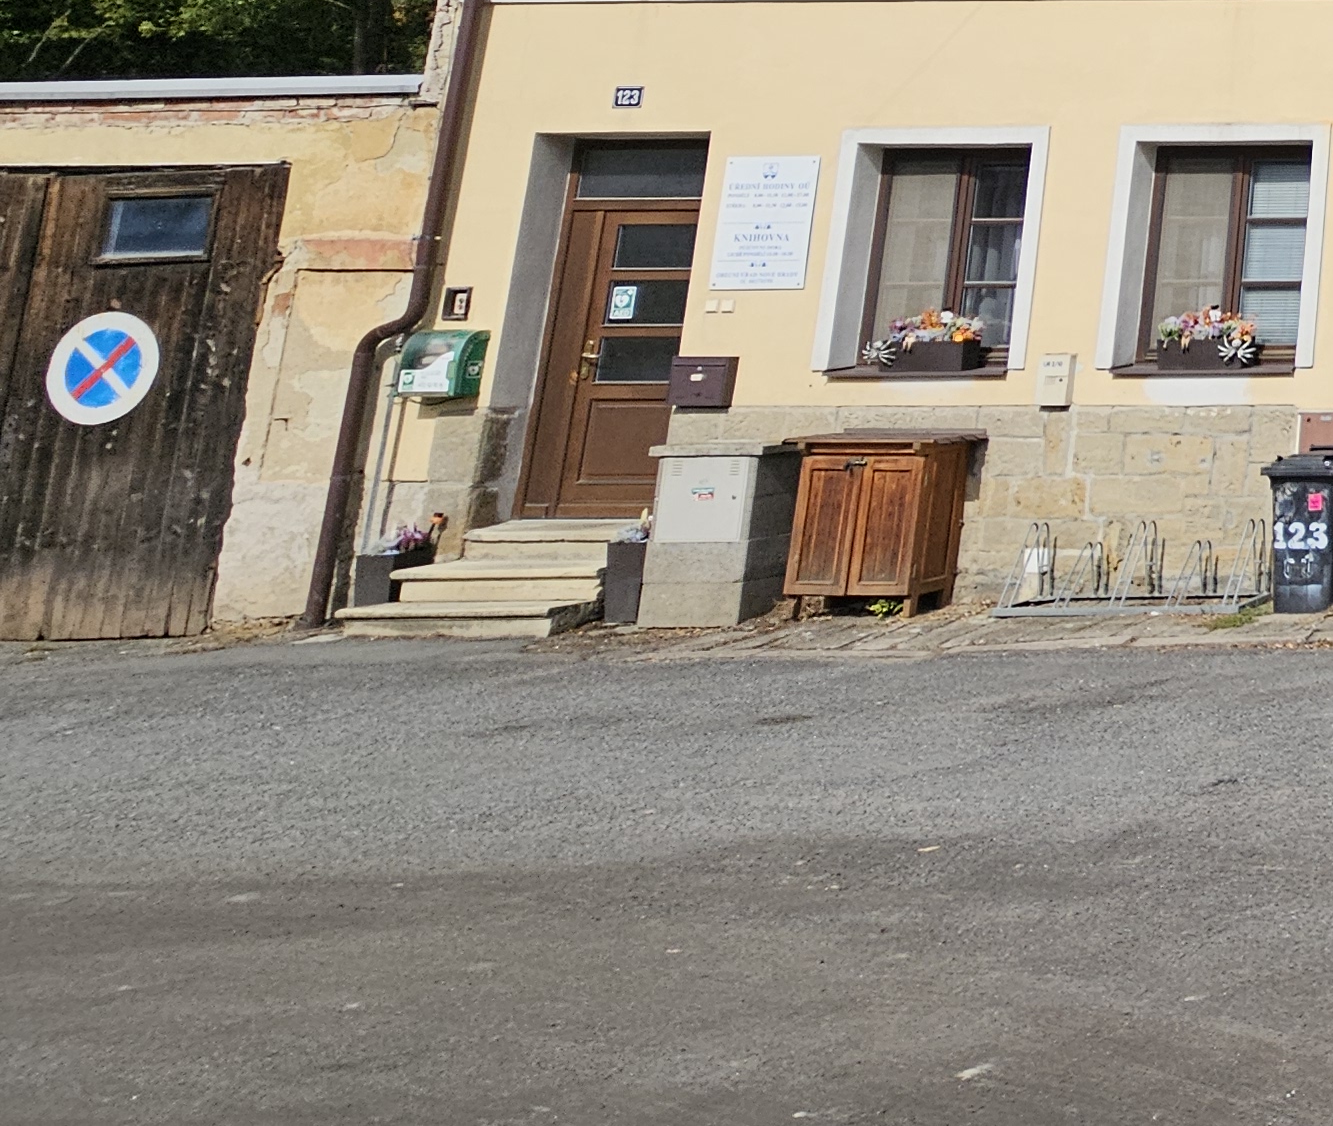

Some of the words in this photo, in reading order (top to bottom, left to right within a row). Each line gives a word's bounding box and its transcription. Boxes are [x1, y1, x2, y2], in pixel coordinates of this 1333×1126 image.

[617, 89, 640, 105] 123
[734, 233, 790, 242] KNIHOVNA
[1273, 521, 1329, 550] 123
